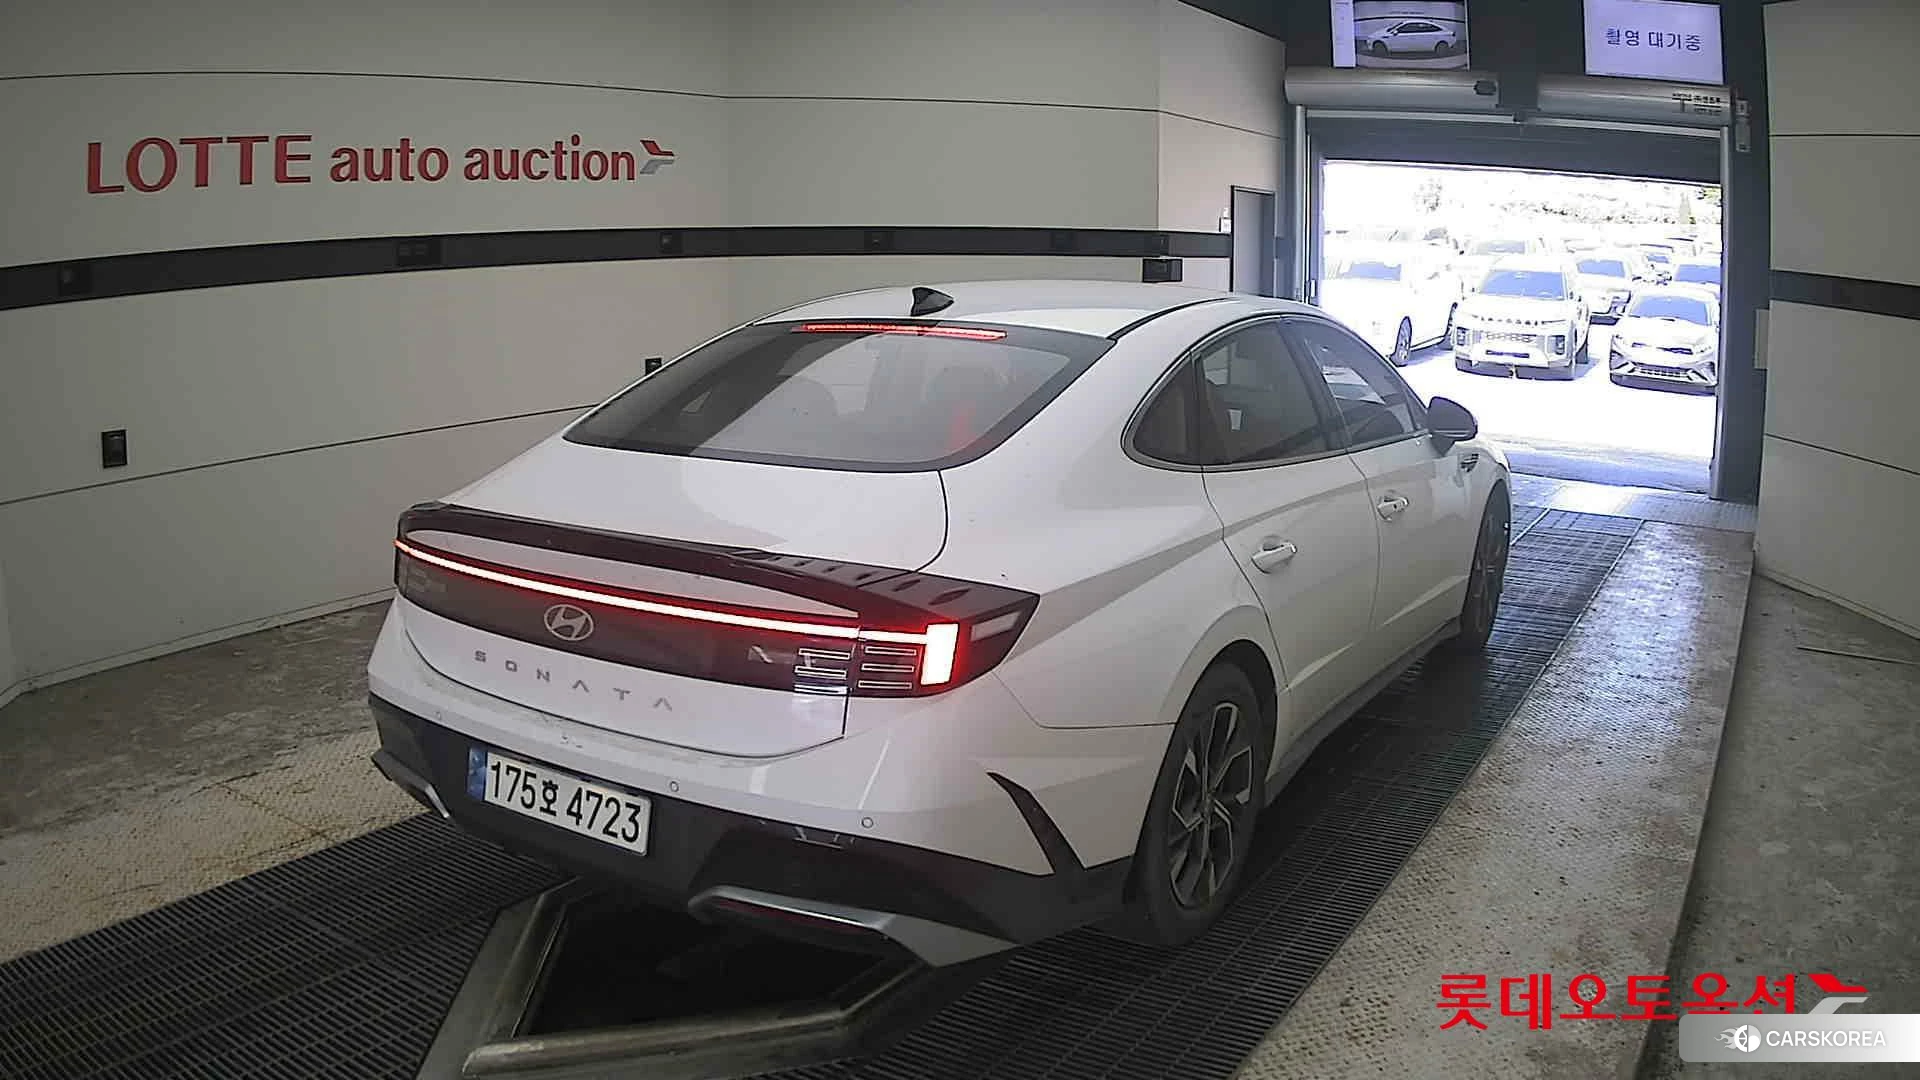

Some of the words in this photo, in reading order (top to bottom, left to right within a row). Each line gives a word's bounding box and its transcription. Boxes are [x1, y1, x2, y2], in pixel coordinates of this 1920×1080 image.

[1648, 31, 1701, 52] 대기중
[86, 134, 312, 194] LOTTE
[330, 138, 449, 182] auto
[463, 134, 636, 182] auction
[474, 650, 673, 712] SONATA
[490, 760, 560, 817] 175호
[566, 786, 642, 843] 4723
